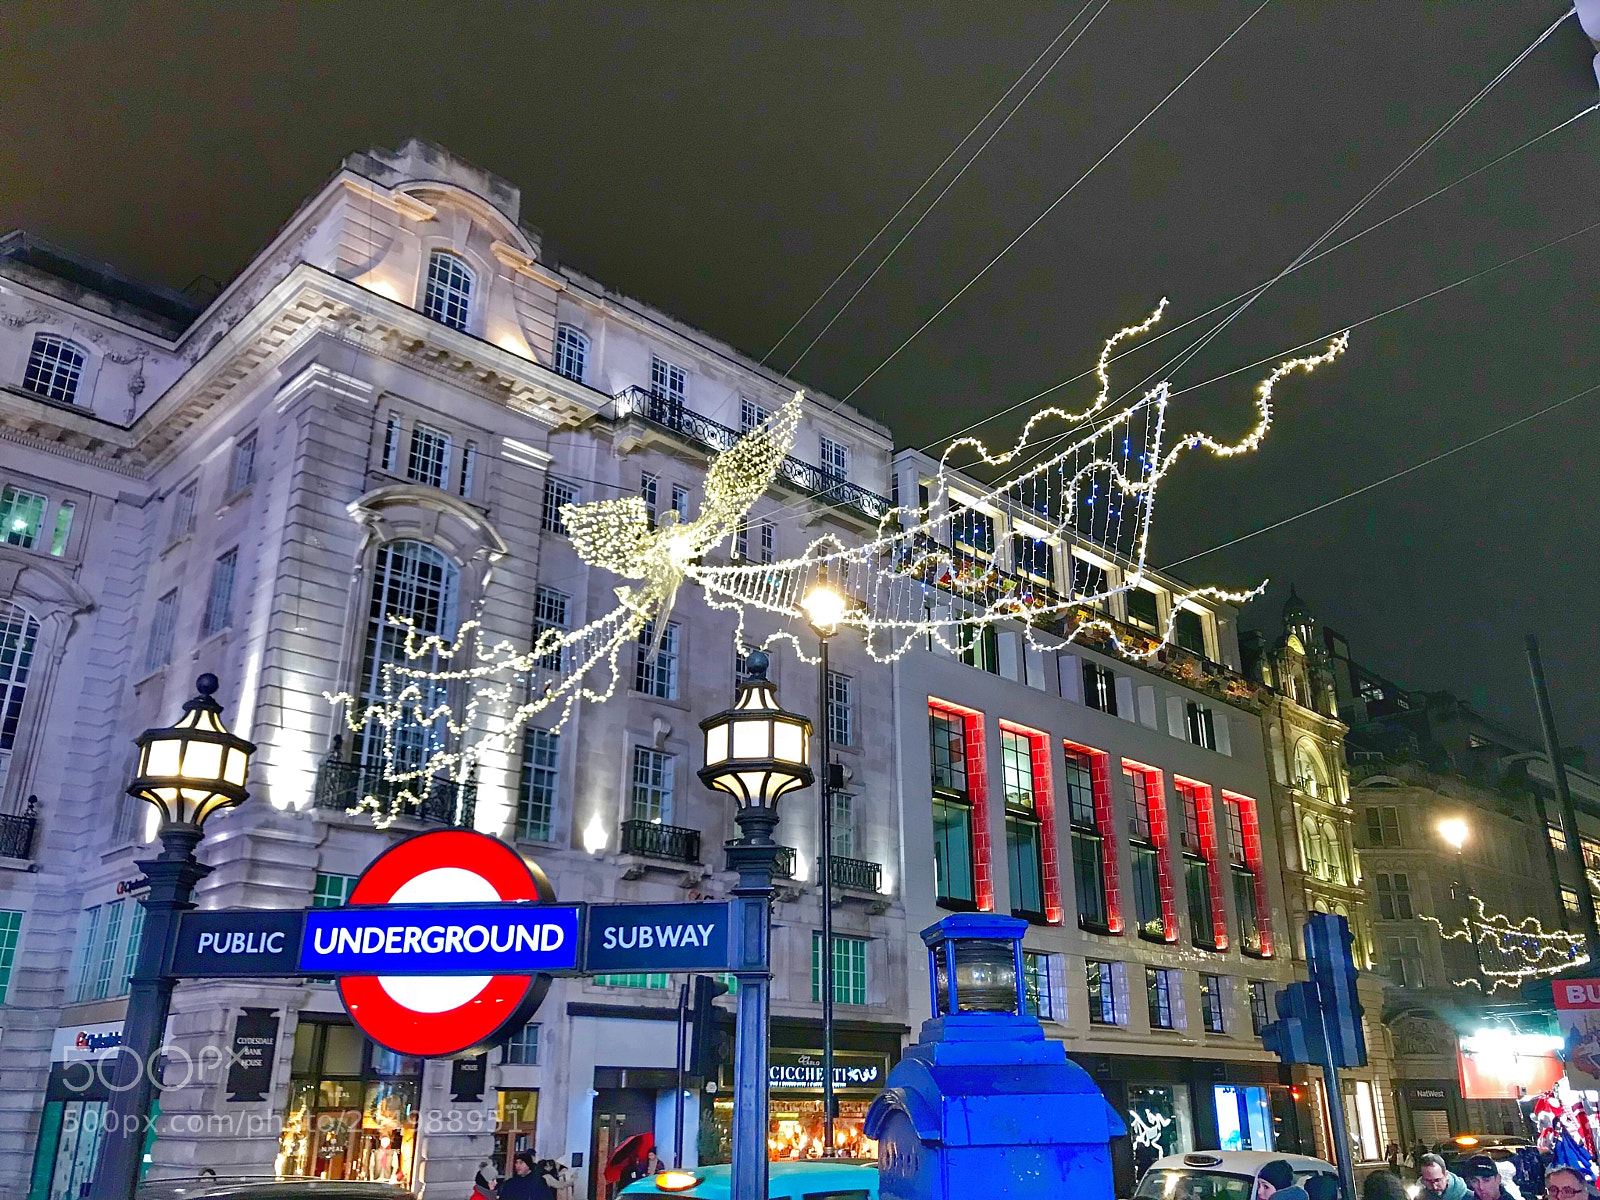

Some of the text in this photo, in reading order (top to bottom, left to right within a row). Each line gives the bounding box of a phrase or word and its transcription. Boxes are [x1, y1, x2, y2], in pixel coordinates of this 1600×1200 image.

[197, 931, 285, 954] PUBLIC
[313, 924, 564, 955] UNDERGROUND
[602, 924, 716, 950] SUBWAY
[244, 1048, 262, 1056] BANK
[769, 1066, 846, 1081] CICCHETI
[1417, 1090, 1445, 1098] NatWest
